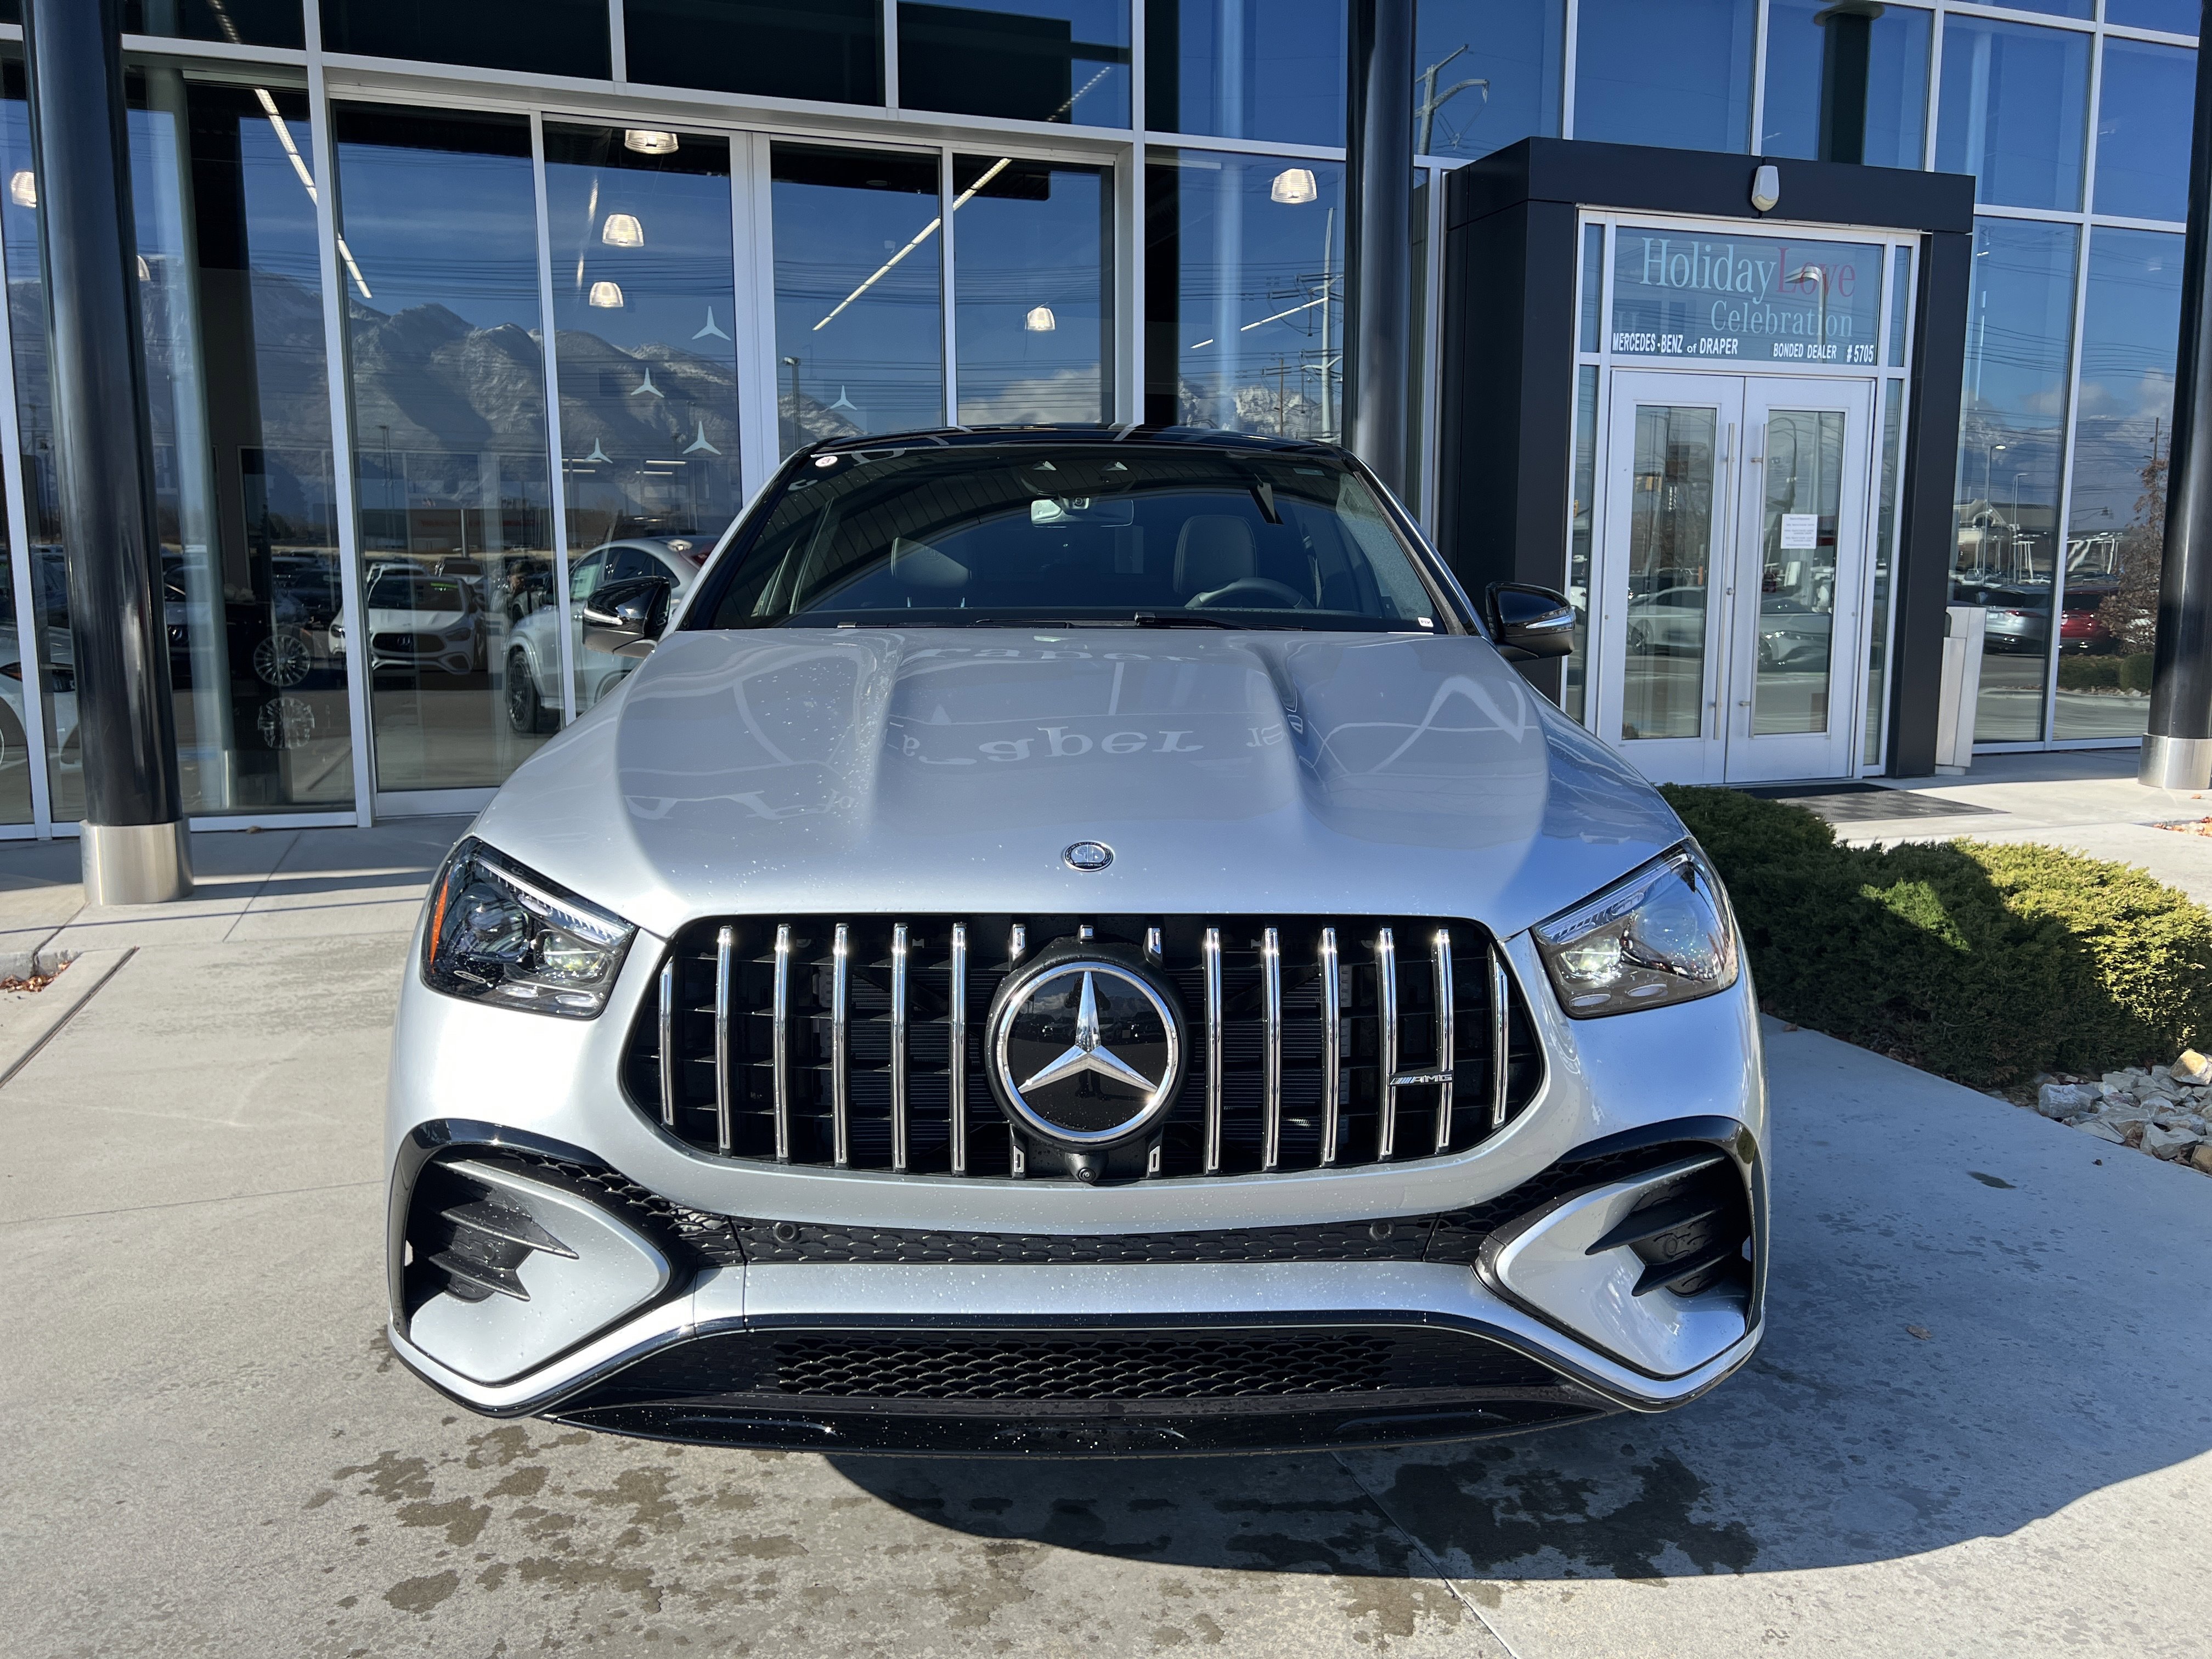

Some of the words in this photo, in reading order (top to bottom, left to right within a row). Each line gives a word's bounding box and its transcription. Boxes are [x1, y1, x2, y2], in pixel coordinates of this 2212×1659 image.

[1639, 237, 1777, 303] Holiday
[1711, 300, 1853, 337] Celebration
[1686, 343, 1697, 354] of
[1700, 338, 1738, 355] DRAPER
[1773, 343, 1804, 358] BONDED
[1807, 345, 1837, 359] DEALER
[1410, 1074, 1452, 1083] AMG
